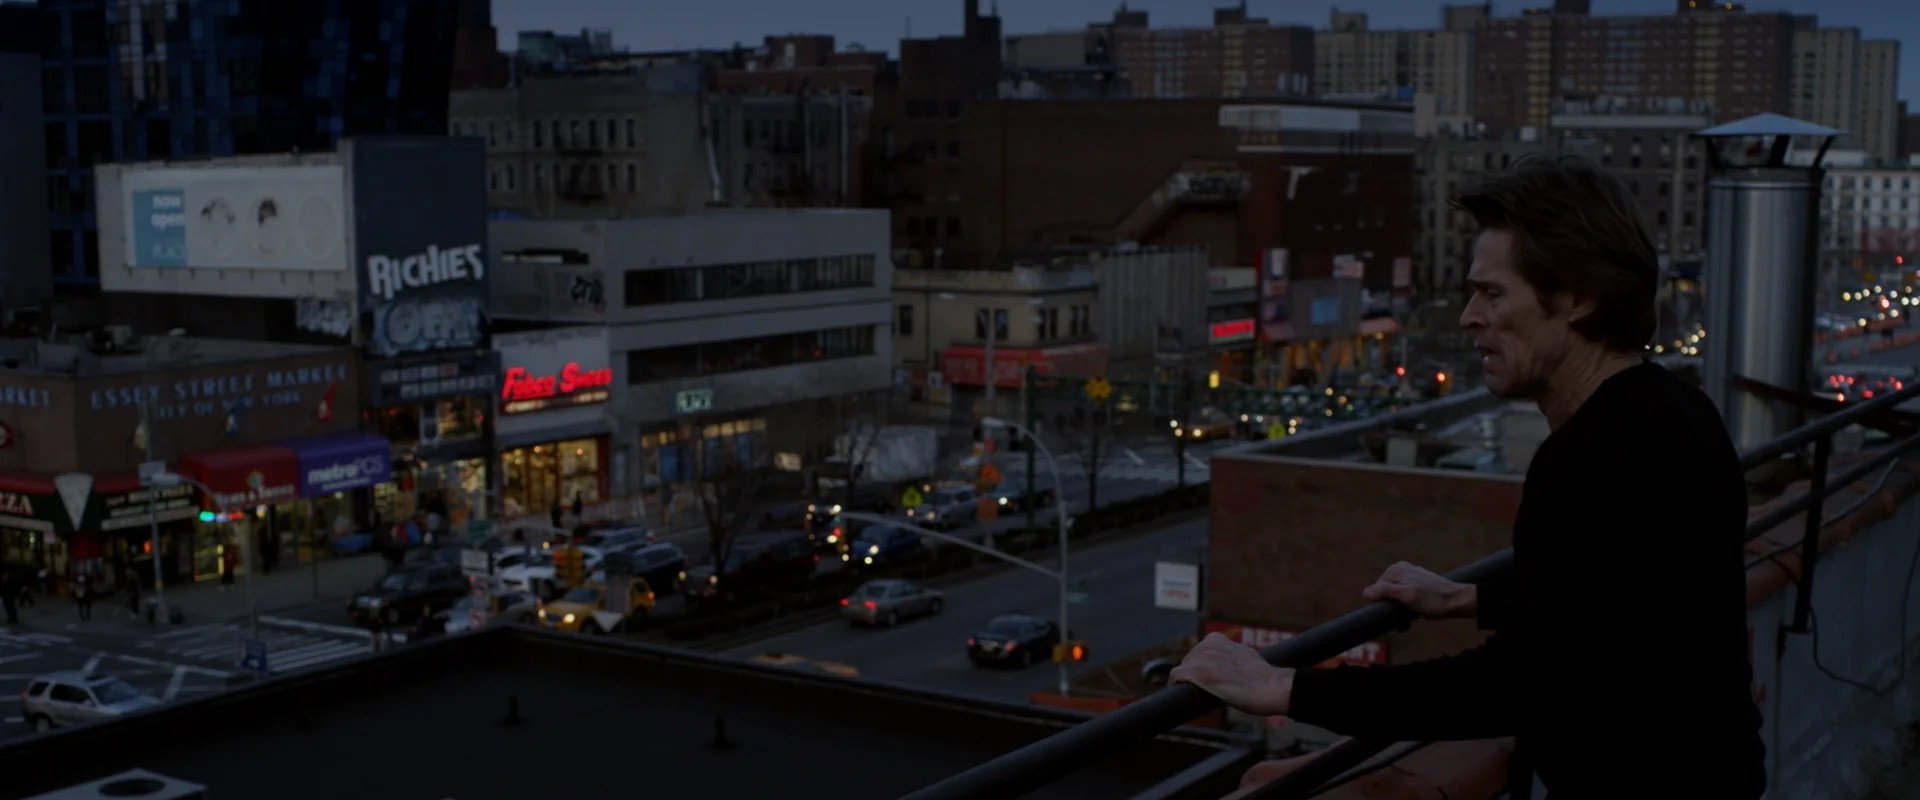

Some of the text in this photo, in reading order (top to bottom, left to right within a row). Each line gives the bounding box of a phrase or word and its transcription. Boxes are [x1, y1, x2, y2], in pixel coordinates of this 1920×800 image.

[0, 387, 51, 408] RKET
[91, 364, 347, 410] ESSEX STREET MARKET
[159, 404, 186, 420] ITY
